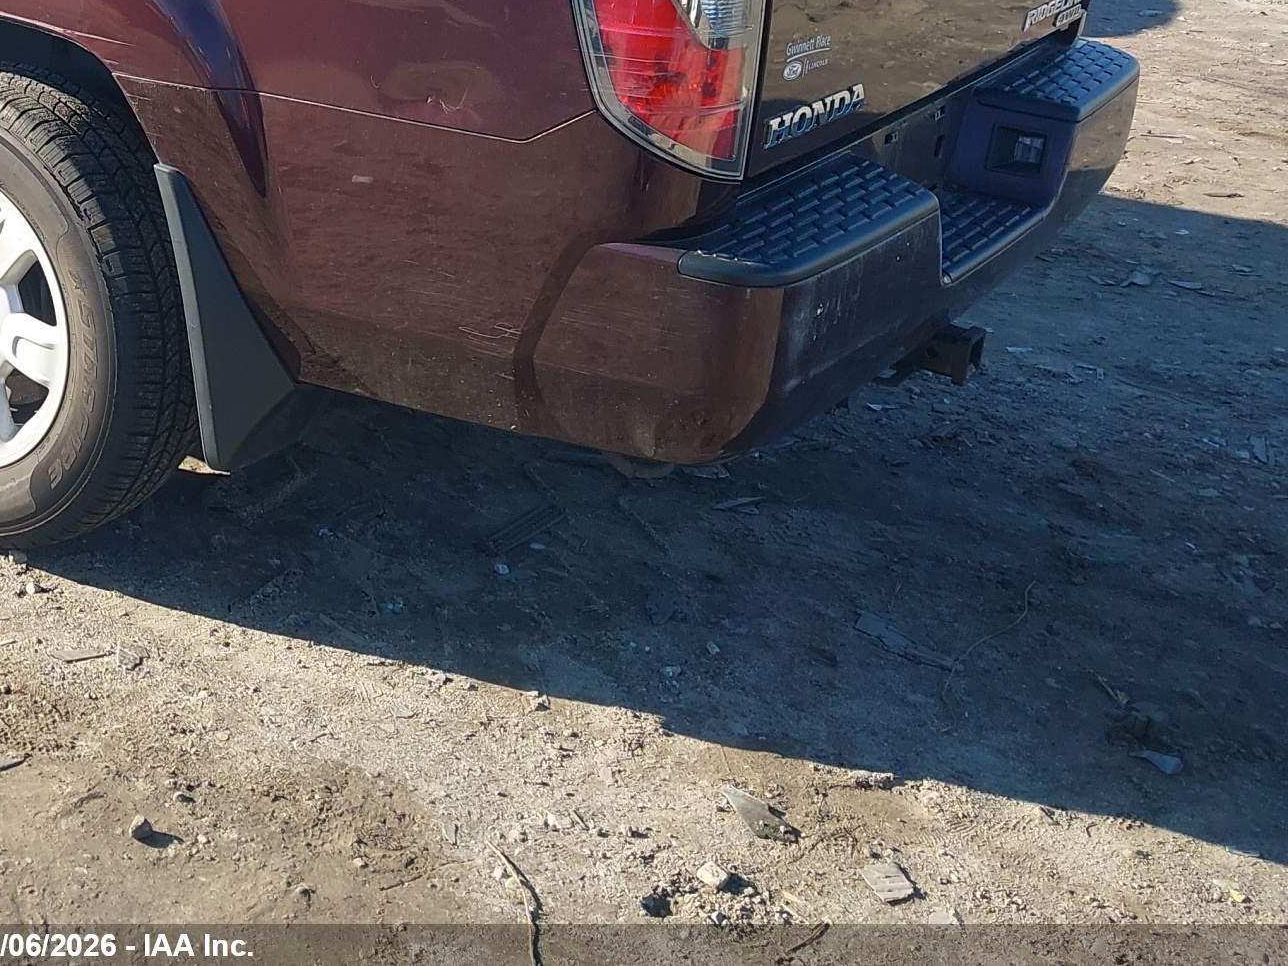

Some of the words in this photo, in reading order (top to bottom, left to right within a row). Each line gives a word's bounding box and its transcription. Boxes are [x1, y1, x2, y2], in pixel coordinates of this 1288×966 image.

[786, 38, 816, 56] Gwinnett
[815, 34, 832, 49] Place
[764, 83, 866, 149] HONDA
